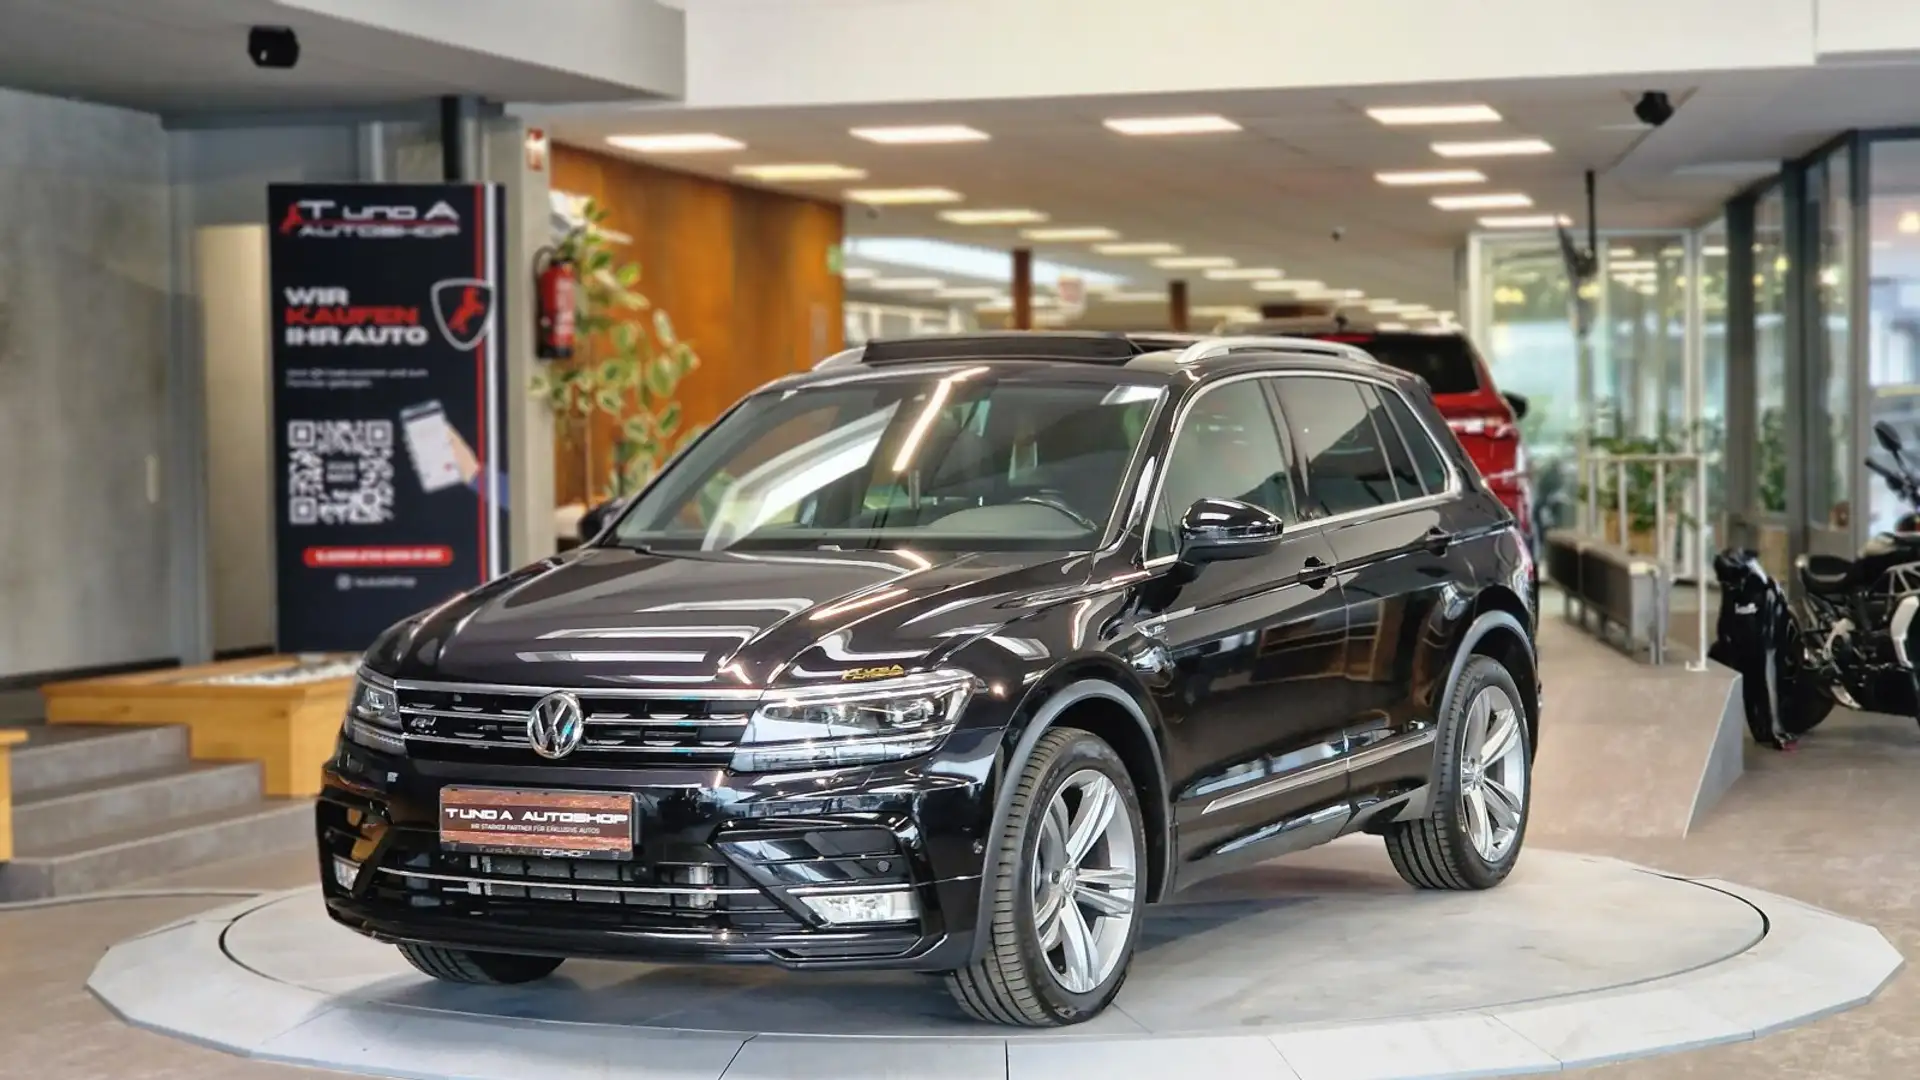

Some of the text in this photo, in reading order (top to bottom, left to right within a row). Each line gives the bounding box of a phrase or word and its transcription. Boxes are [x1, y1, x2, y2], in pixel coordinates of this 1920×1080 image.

[298, 224, 461, 238] AUTOSHOP
[284, 286, 350, 306] WIR
[285, 305, 419, 325] KAUFEN
[285, 326, 428, 345] IHR AUTO
[521, 810, 628, 825] AUTOSHOP
[506, 824, 533, 832] PARTNER
[578, 826, 600, 834] AUTOS
